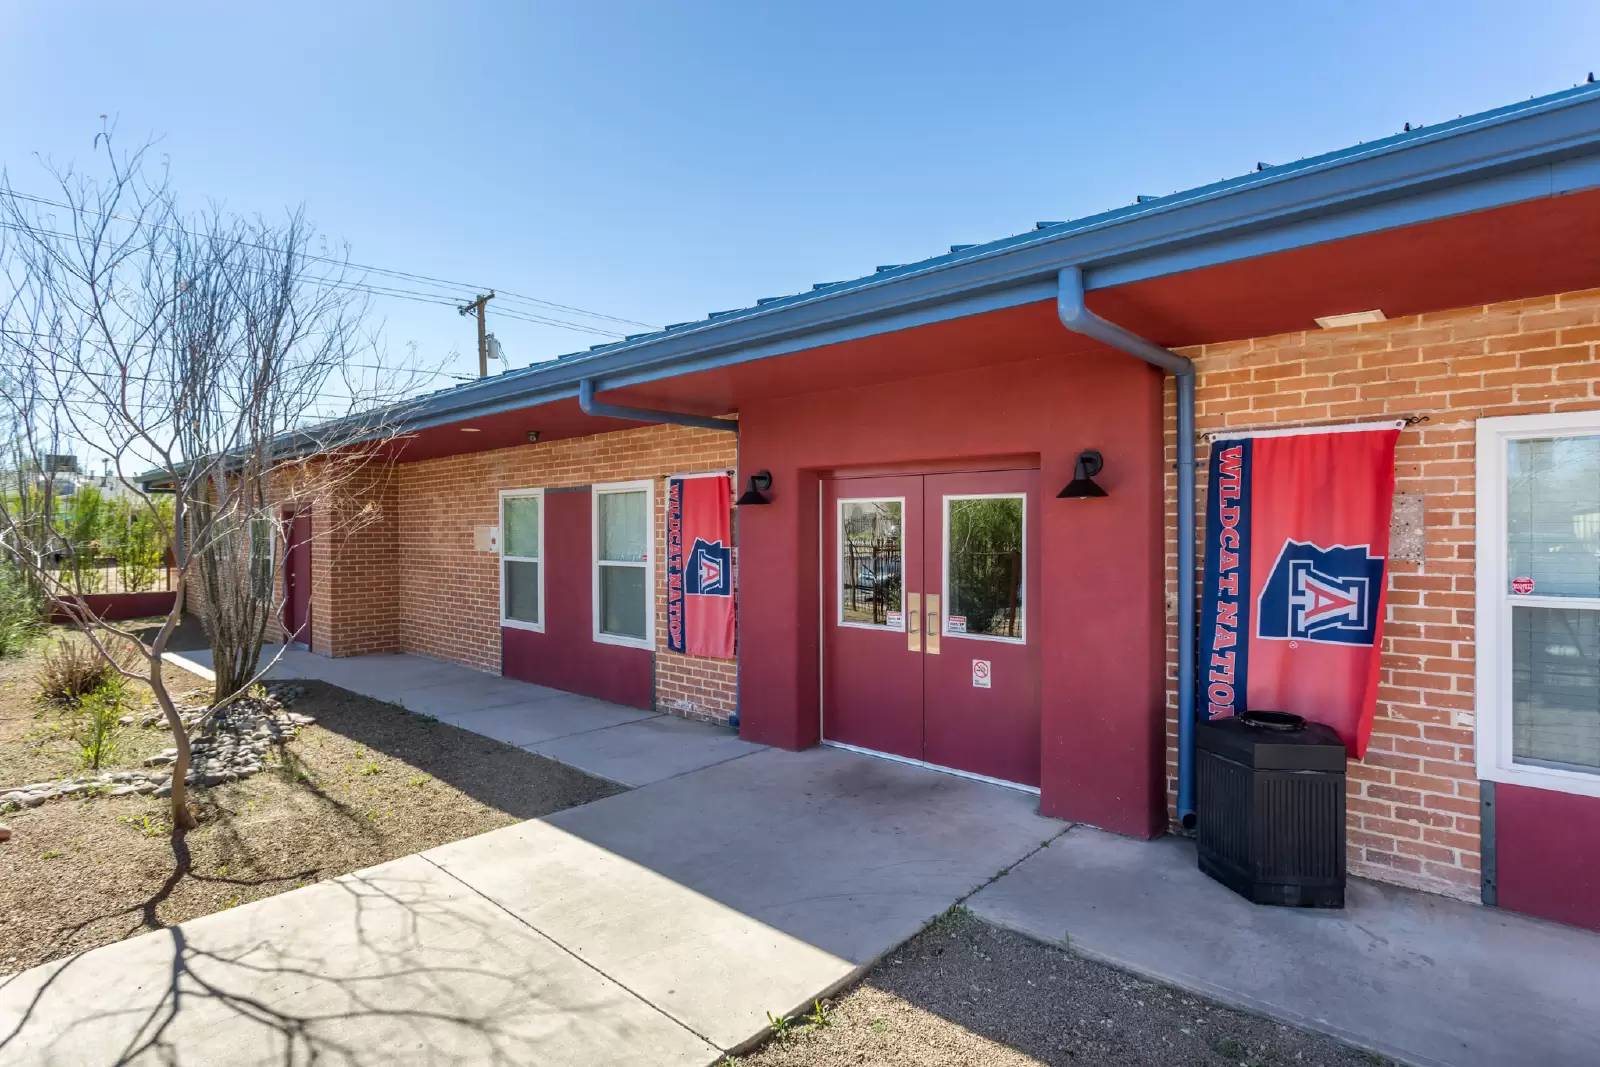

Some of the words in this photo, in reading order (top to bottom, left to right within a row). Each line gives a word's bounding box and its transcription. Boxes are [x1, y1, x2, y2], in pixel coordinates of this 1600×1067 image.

[1218, 445, 1242, 596] WILDCAT
[700, 553, 721, 591] A
[1293, 564, 1364, 634] A
